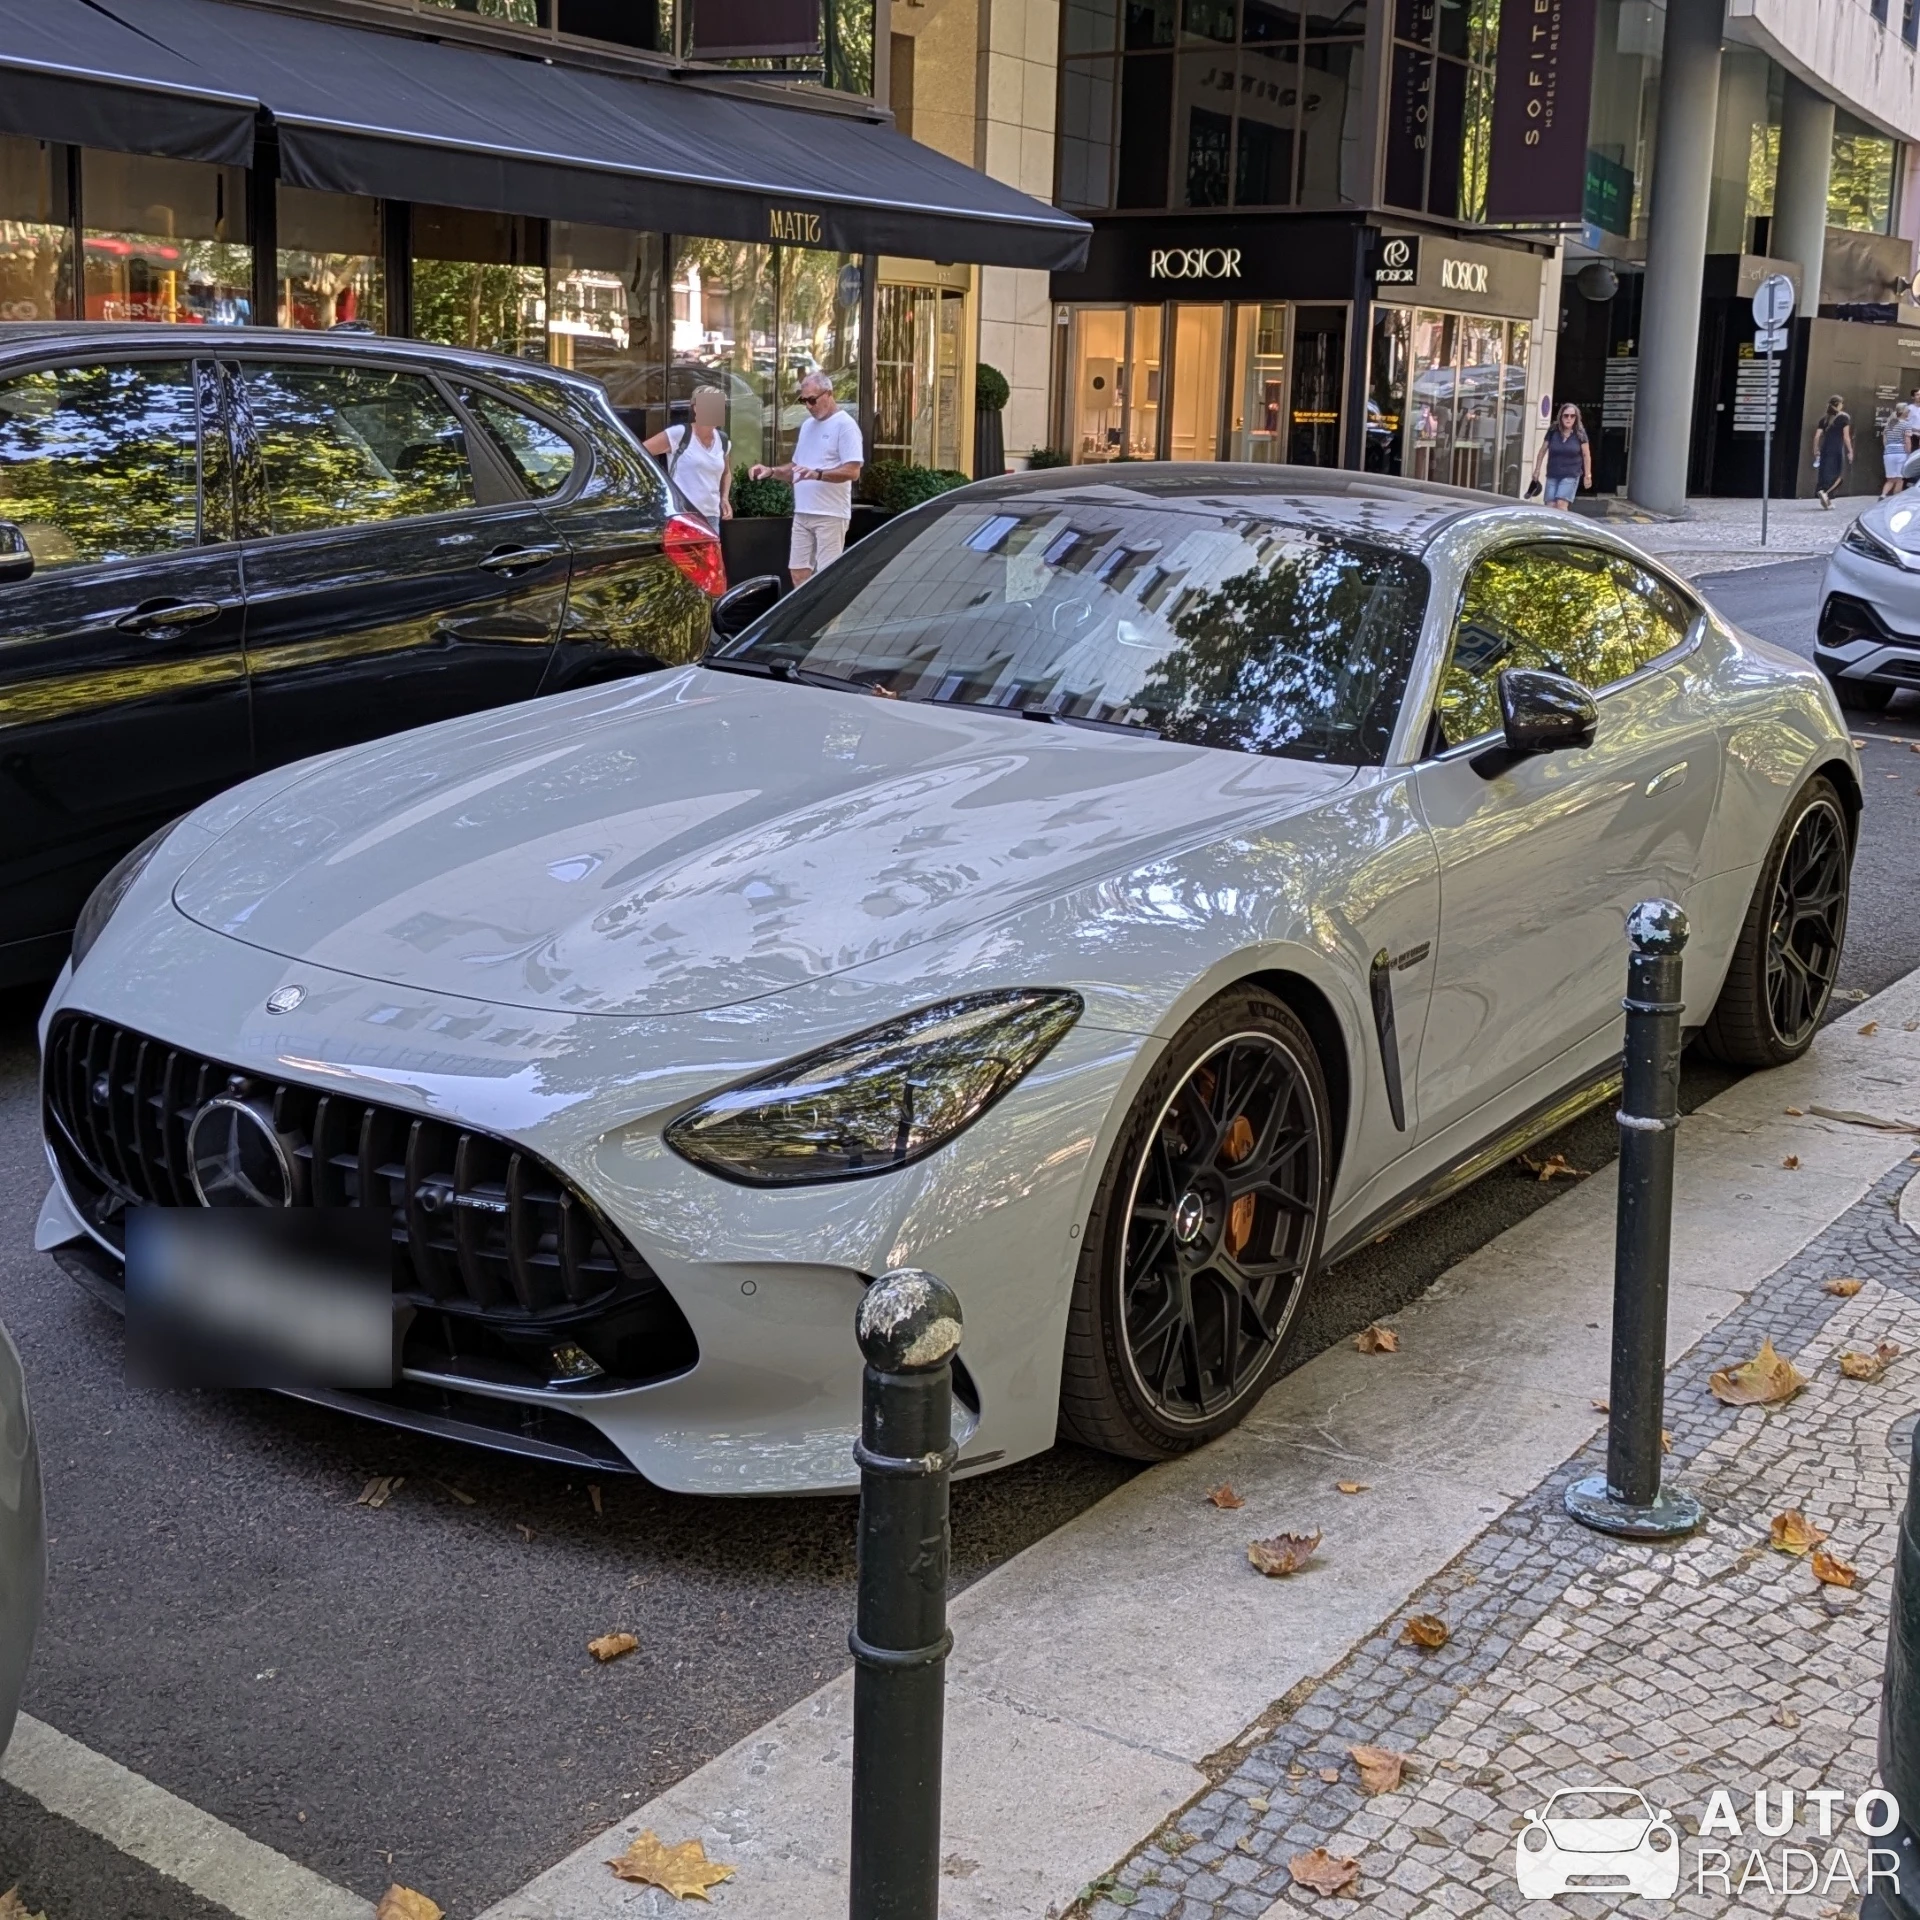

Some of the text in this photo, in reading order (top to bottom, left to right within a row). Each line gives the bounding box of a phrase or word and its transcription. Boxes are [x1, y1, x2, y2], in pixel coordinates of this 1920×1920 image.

[1550, 0, 1561, 50] RESOR
[1545, 72, 1556, 127] HOTELS
[1150, 248, 1242, 278] ROSIOR
[1375, 269, 1414, 281] ROSIOR
[1442, 258, 1488, 293] ROSIOR
